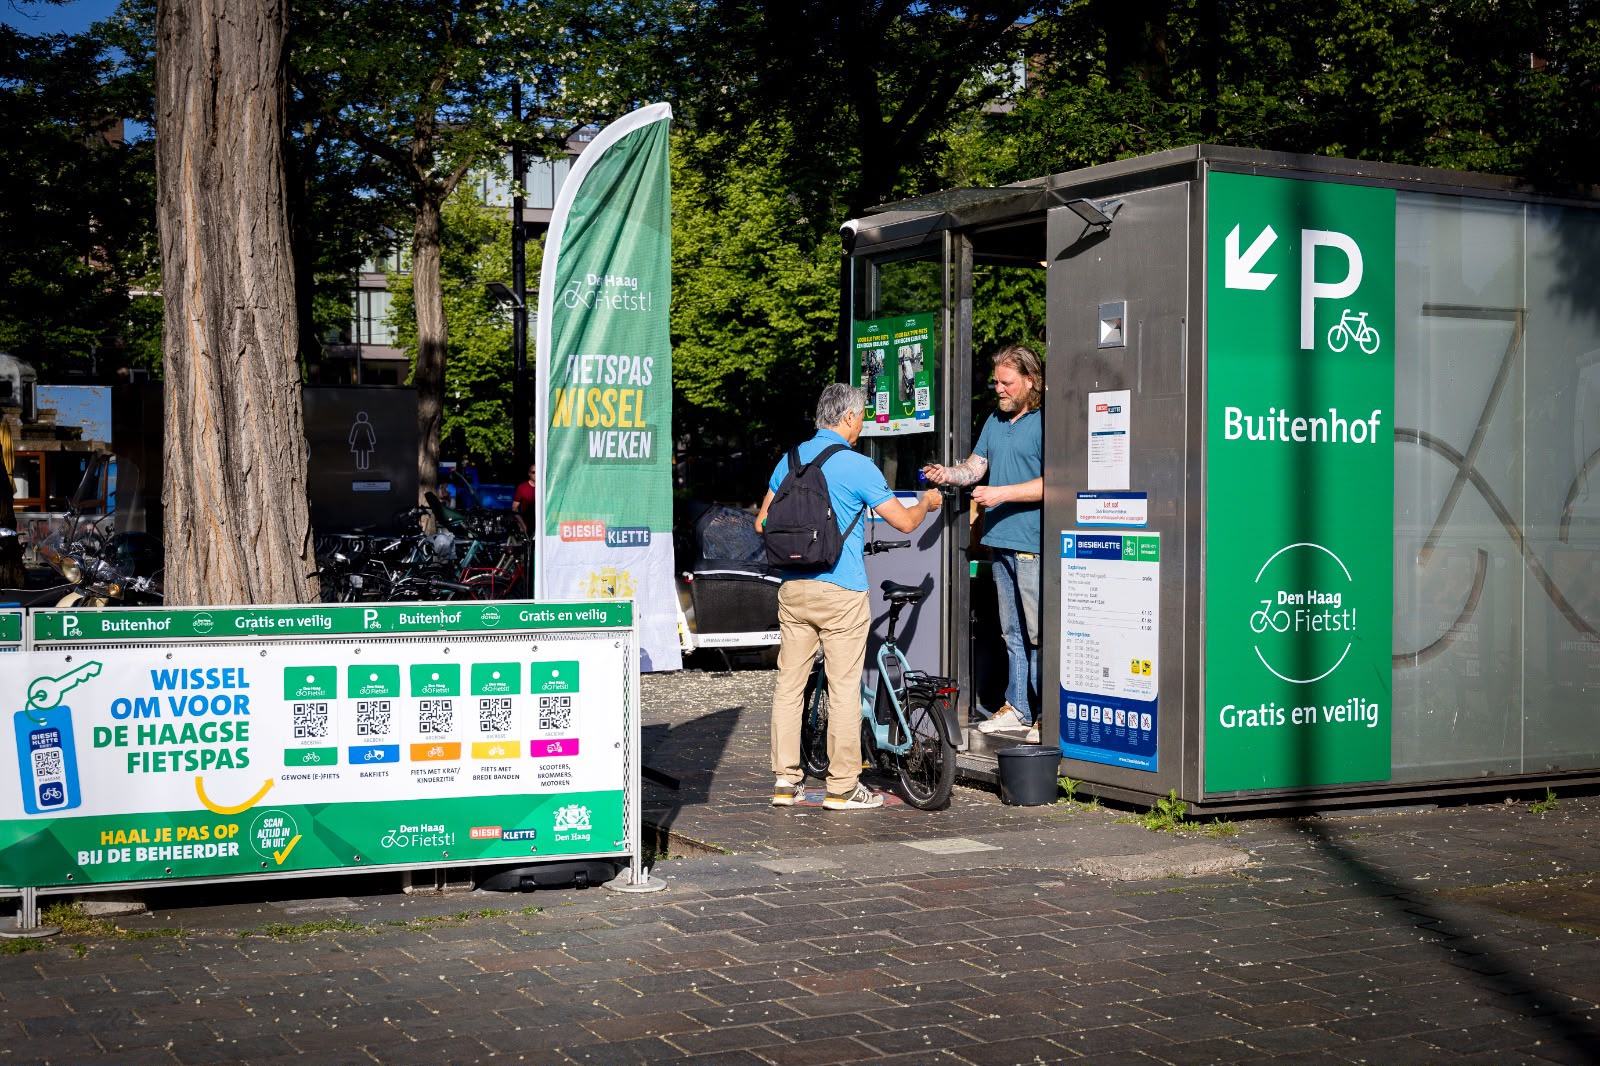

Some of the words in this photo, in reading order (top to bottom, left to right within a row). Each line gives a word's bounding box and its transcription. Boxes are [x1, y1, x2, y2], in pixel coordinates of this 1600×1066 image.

[605, 274, 638, 291] Haag
[1300, 228, 1363, 350] P
[595, 290, 652, 311] Fietst!
[552, 387, 646, 428] WISSEL
[1224, 406, 1381, 444] Buitenhof
[589, 430, 652, 459] WEKEN
[563, 524, 603, 538] BIESIE
[607, 530, 649, 544] KLETTE
[1063, 537, 1073, 554] P
[1277, 590, 1304, 605] Den
[1307, 590, 1342, 608] Haag
[63, 615, 79, 637] P
[101, 618, 171, 632] Buitenhof
[235, 616, 275, 629] Gratis
[277, 618, 294, 628] en
[297, 614, 332, 630] veilig
[363, 609, 378, 629] P
[399, 611, 462, 625] Buitenhof
[519, 610, 555, 622] Gratis
[558, 612, 572, 621] en
[574, 608, 607, 623] veilig
[1295, 607, 1356, 632] Fietst!
[150, 667, 250, 690] WISSEL
[110, 696, 161, 720] OM
[168, 694, 250, 717] VOOR
[1219, 702, 1286, 729] Gratis
[1291, 705, 1317, 726] en
[1322, 697, 1379, 728] veilig
[31, 731, 58, 741] BIESIE
[93, 725, 128, 748] DE
[137, 721, 250, 746] HAAGSE
[127, 747, 250, 774] FIETSPAS
[539, 763, 571, 771] SCOOTERS,
[281, 773, 311, 781] GEWONE
[256, 828, 280, 839] ALTIJD
[281, 827, 291, 837] IN
[263, 817, 284, 828] SCAN
[400, 824, 419, 833] Den
[420, 823, 445, 834] Haag
[100, 828, 150, 846] HAAL
[154, 827, 172, 843] JE
[176, 825, 210, 842] PAS
[213, 823, 239, 840] OP
[411, 832, 455, 847] Fietst!
[471, 828, 500, 838] BIESIE
[503, 830, 535, 840] KLETTE
[571, 833, 591, 842] Haag
[77, 849, 103, 866] BIJ
[107, 847, 131, 864] DE
[135, 841, 239, 863] BEHEERDER
